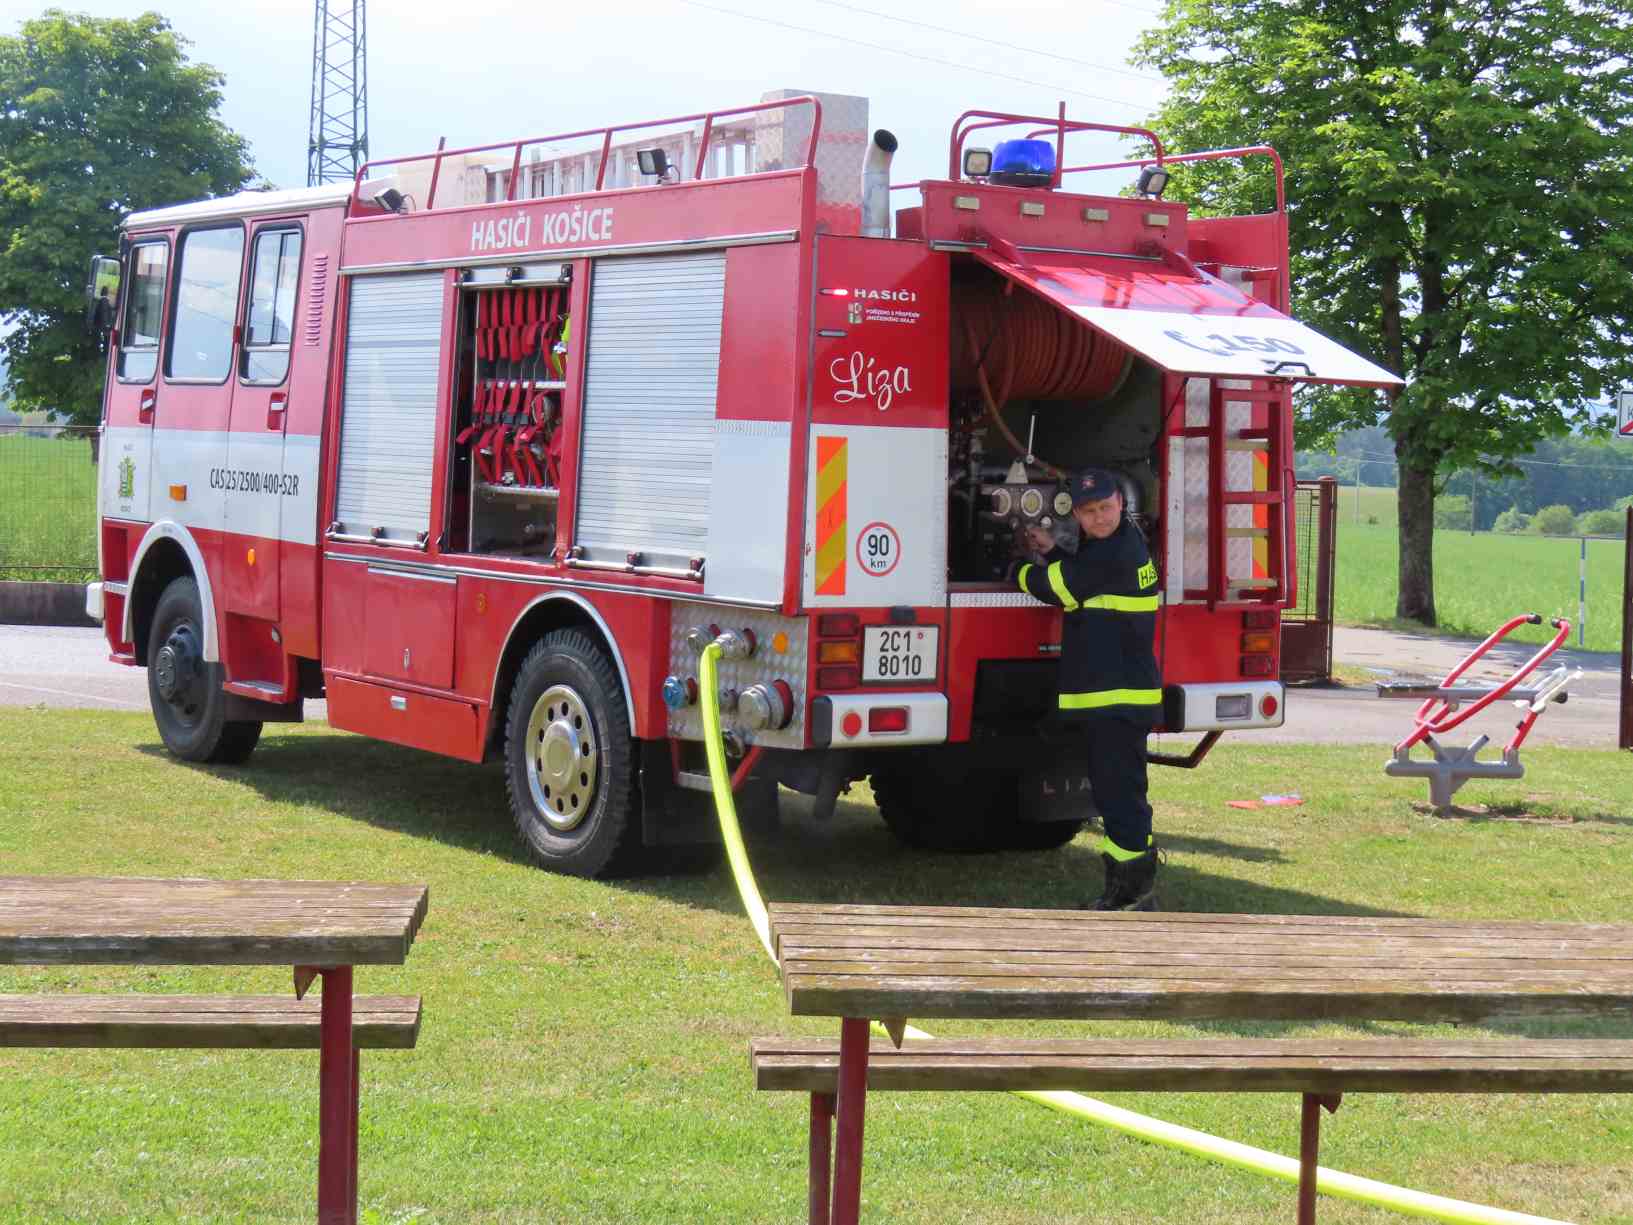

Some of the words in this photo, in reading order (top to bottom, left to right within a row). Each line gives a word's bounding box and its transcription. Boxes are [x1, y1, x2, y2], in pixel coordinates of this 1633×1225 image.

[472, 210, 531, 250] HASIČI
[543, 204, 614, 244] KOŠICE
[854, 288, 917, 302] HASIČI
[830, 351, 912, 411] Líza
[867, 534, 890, 556] 90
[870, 558, 887, 568] km
[879, 631, 912, 652] 2C1
[878, 655, 922, 676] 8010
[1042, 776, 1092, 793] LIA
